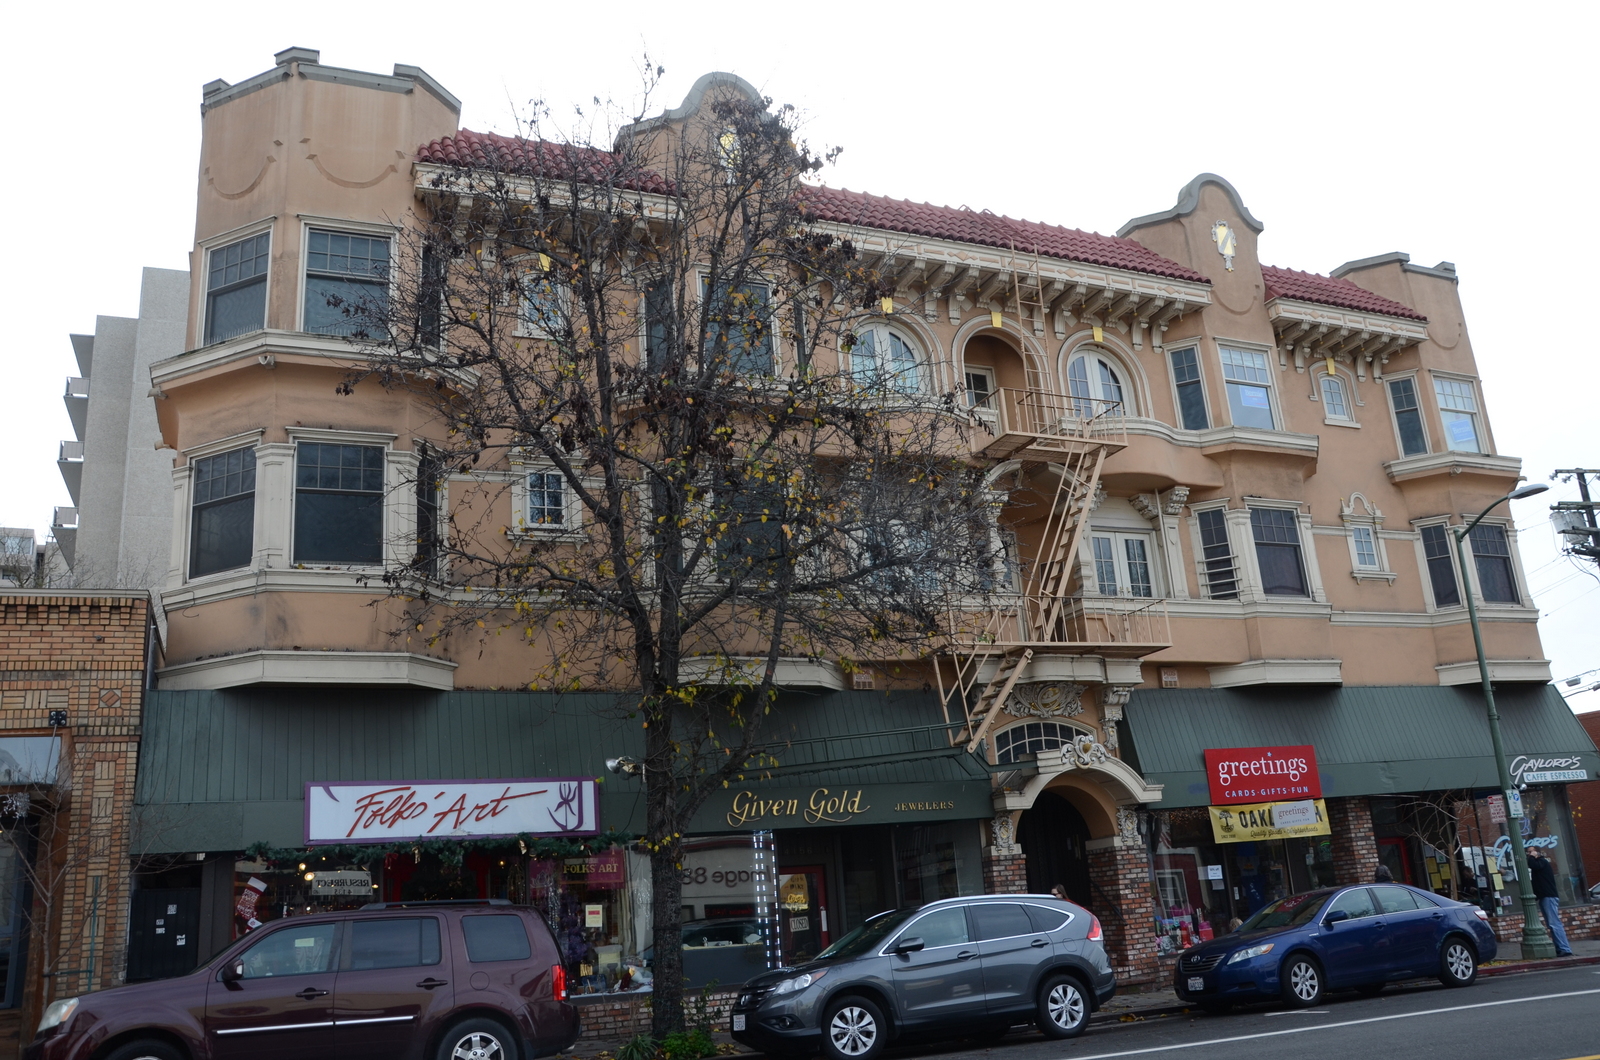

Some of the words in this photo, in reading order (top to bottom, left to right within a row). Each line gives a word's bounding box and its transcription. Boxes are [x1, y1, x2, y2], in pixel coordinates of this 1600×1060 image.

[1218, 752, 1308, 786] greetings
[1509, 755, 1582, 785] GAYLORD'S
[1525, 773, 1548, 782] CAFFE
[1550, 770, 1586, 780] ESPRESSO
[1224, 788, 1256, 798] CARDS
[1260, 786, 1288, 796] GIFTS
[1291, 785, 1309, 794] FUN
[426, 786, 549, 834] Art
[726, 790, 799, 828] Given
[803, 788, 871, 824] Gold
[894, 800, 955, 812] JEWELERS
[1278, 805, 1310, 819] greetings
[598, 863, 619, 873] ART
[790, 918, 809, 931] CLOSED
